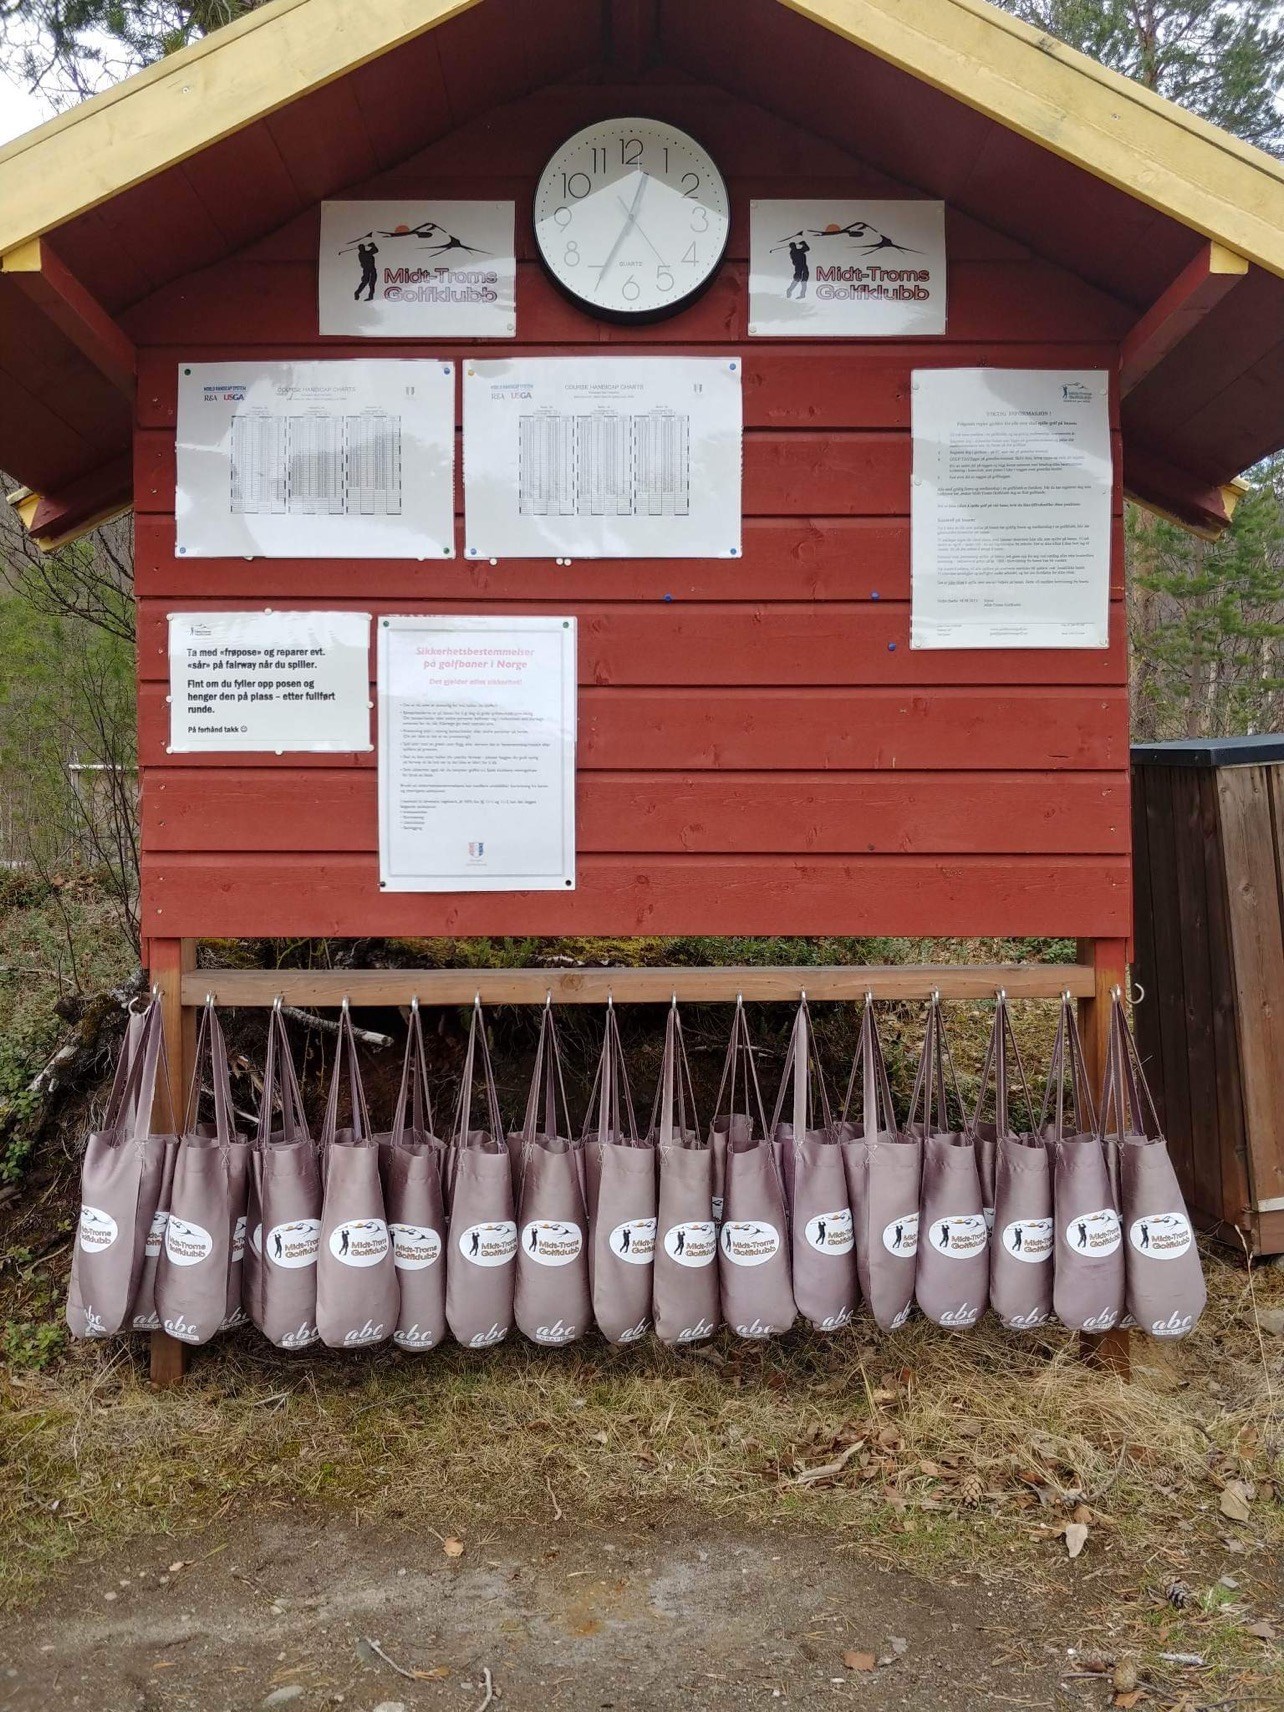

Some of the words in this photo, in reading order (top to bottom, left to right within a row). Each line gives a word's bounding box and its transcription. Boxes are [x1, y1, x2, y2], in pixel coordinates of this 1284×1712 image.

[619, 138, 644, 165] 12
[591, 147, 606, 174] 11
[663, 147, 669, 174] 1
[561, 172, 592, 199] 10
[681, 172, 700, 199] 2
[554, 206, 573, 233] 9
[690, 206, 709, 233] 3
[564, 240, 580, 267] 8
[680, 241, 700, 267] 4
[384, 268, 498, 284] Midt-Troms
[588, 265, 606, 292] 7
[656, 265, 675, 292] 5
[816, 266, 930, 282] Midt-Troms
[384, 286, 498, 303] Golfklubb
[621, 274, 640, 301] 6
[816, 284, 930, 301] Golfklubb
[223, 393, 245, 401] USGA
[187, 648, 197, 657] Ta
[199, 648, 217, 656] med
[220, 648, 261, 658] «frøpose»
[264, 650, 275, 658] og
[277, 649, 308, 658] reparer
[416, 647, 535, 657] Sikkerhetsbestemmelser
[187, 660, 210, 669] «sår»
[213, 660, 223, 671] på
[226, 660, 256, 671] fairway
[258, 660, 273, 669] når
[275, 660, 286, 669] du
[288, 660, 318, 671] spiller.
[423, 659, 436, 670] på
[439, 659, 488, 670] golfbaner
[496, 660, 528, 670] Norge
[187, 680, 204, 688] Fint
[221, 680, 232, 688] du
[234, 680, 256, 690] fyller
[258, 682, 274, 690] opp
[276, 681, 302, 690] posen
[304, 681, 315, 690] og
[443, 678, 468, 687] gjelder
[187, 692, 217, 702] henger
[219, 692, 236, 701] den
[238, 691, 249, 702] på
[250, 692, 274, 702] plass
[282, 692, 303, 701] etter
[305, 692, 336, 701] fullført
[187, 705, 215, 714] runde.
[198, 725, 223, 733] forhånd
[395, 1243, 438, 1254] Midt-Troms
[539, 1246, 580, 1257] Golfklubb
[732, 1239, 775, 1249] Midt-Troms
[733, 1246, 776, 1256] Golfklubb
[395, 1251, 438, 1261] Golfklubb
[940, 1302, 978, 1320] abc
[1010, 1307, 1048, 1324] abc
[1083, 1306, 1118, 1327] abc
[164, 1315, 198, 1334] abc
[536, 1319, 576, 1336] abc
[679, 1318, 714, 1338] abc
[736, 1318, 774, 1334] abc
[1152, 1310, 1192, 1330] abc
[345, 1319, 384, 1340] abc
[394, 1324, 432, 1341] abc
[471, 1323, 508, 1343] abc
